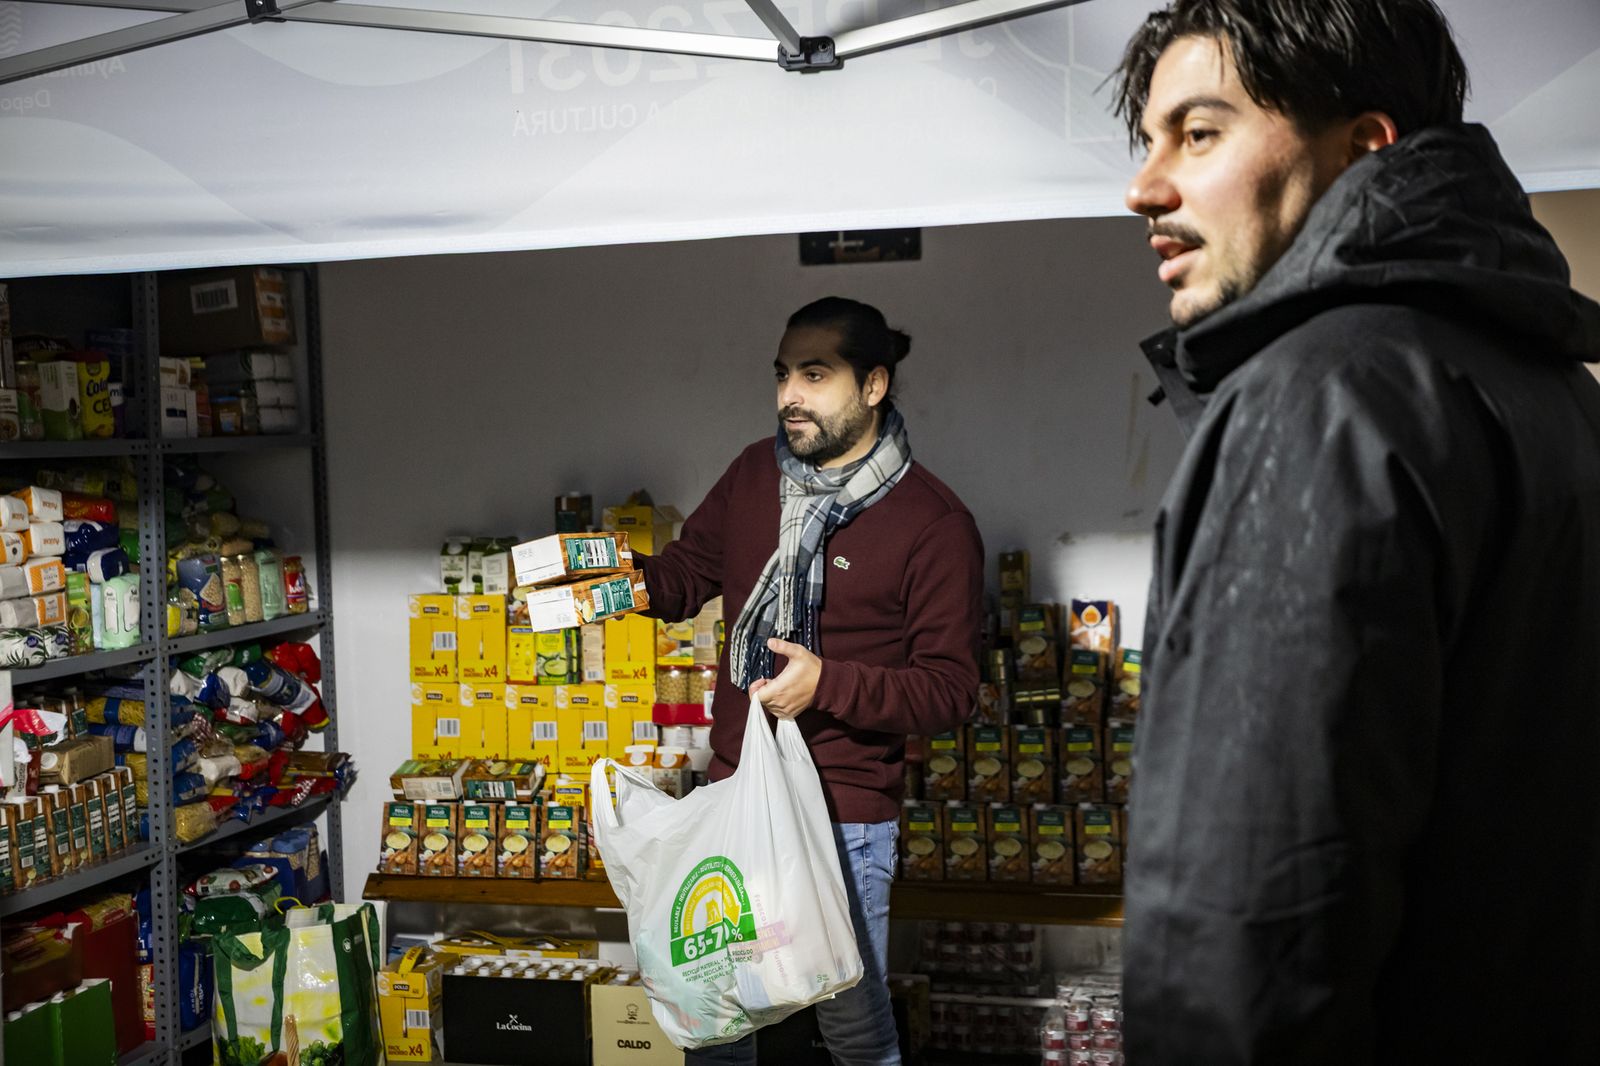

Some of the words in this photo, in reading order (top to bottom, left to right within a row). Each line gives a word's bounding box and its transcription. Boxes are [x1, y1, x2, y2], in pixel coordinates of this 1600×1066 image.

[435, 665, 449, 678] x4
[484, 665, 498, 678] x4
[632, 667, 648, 680] x4
[409, 1044, 424, 1056] x4
[617, 1039, 651, 1050] CALDO
